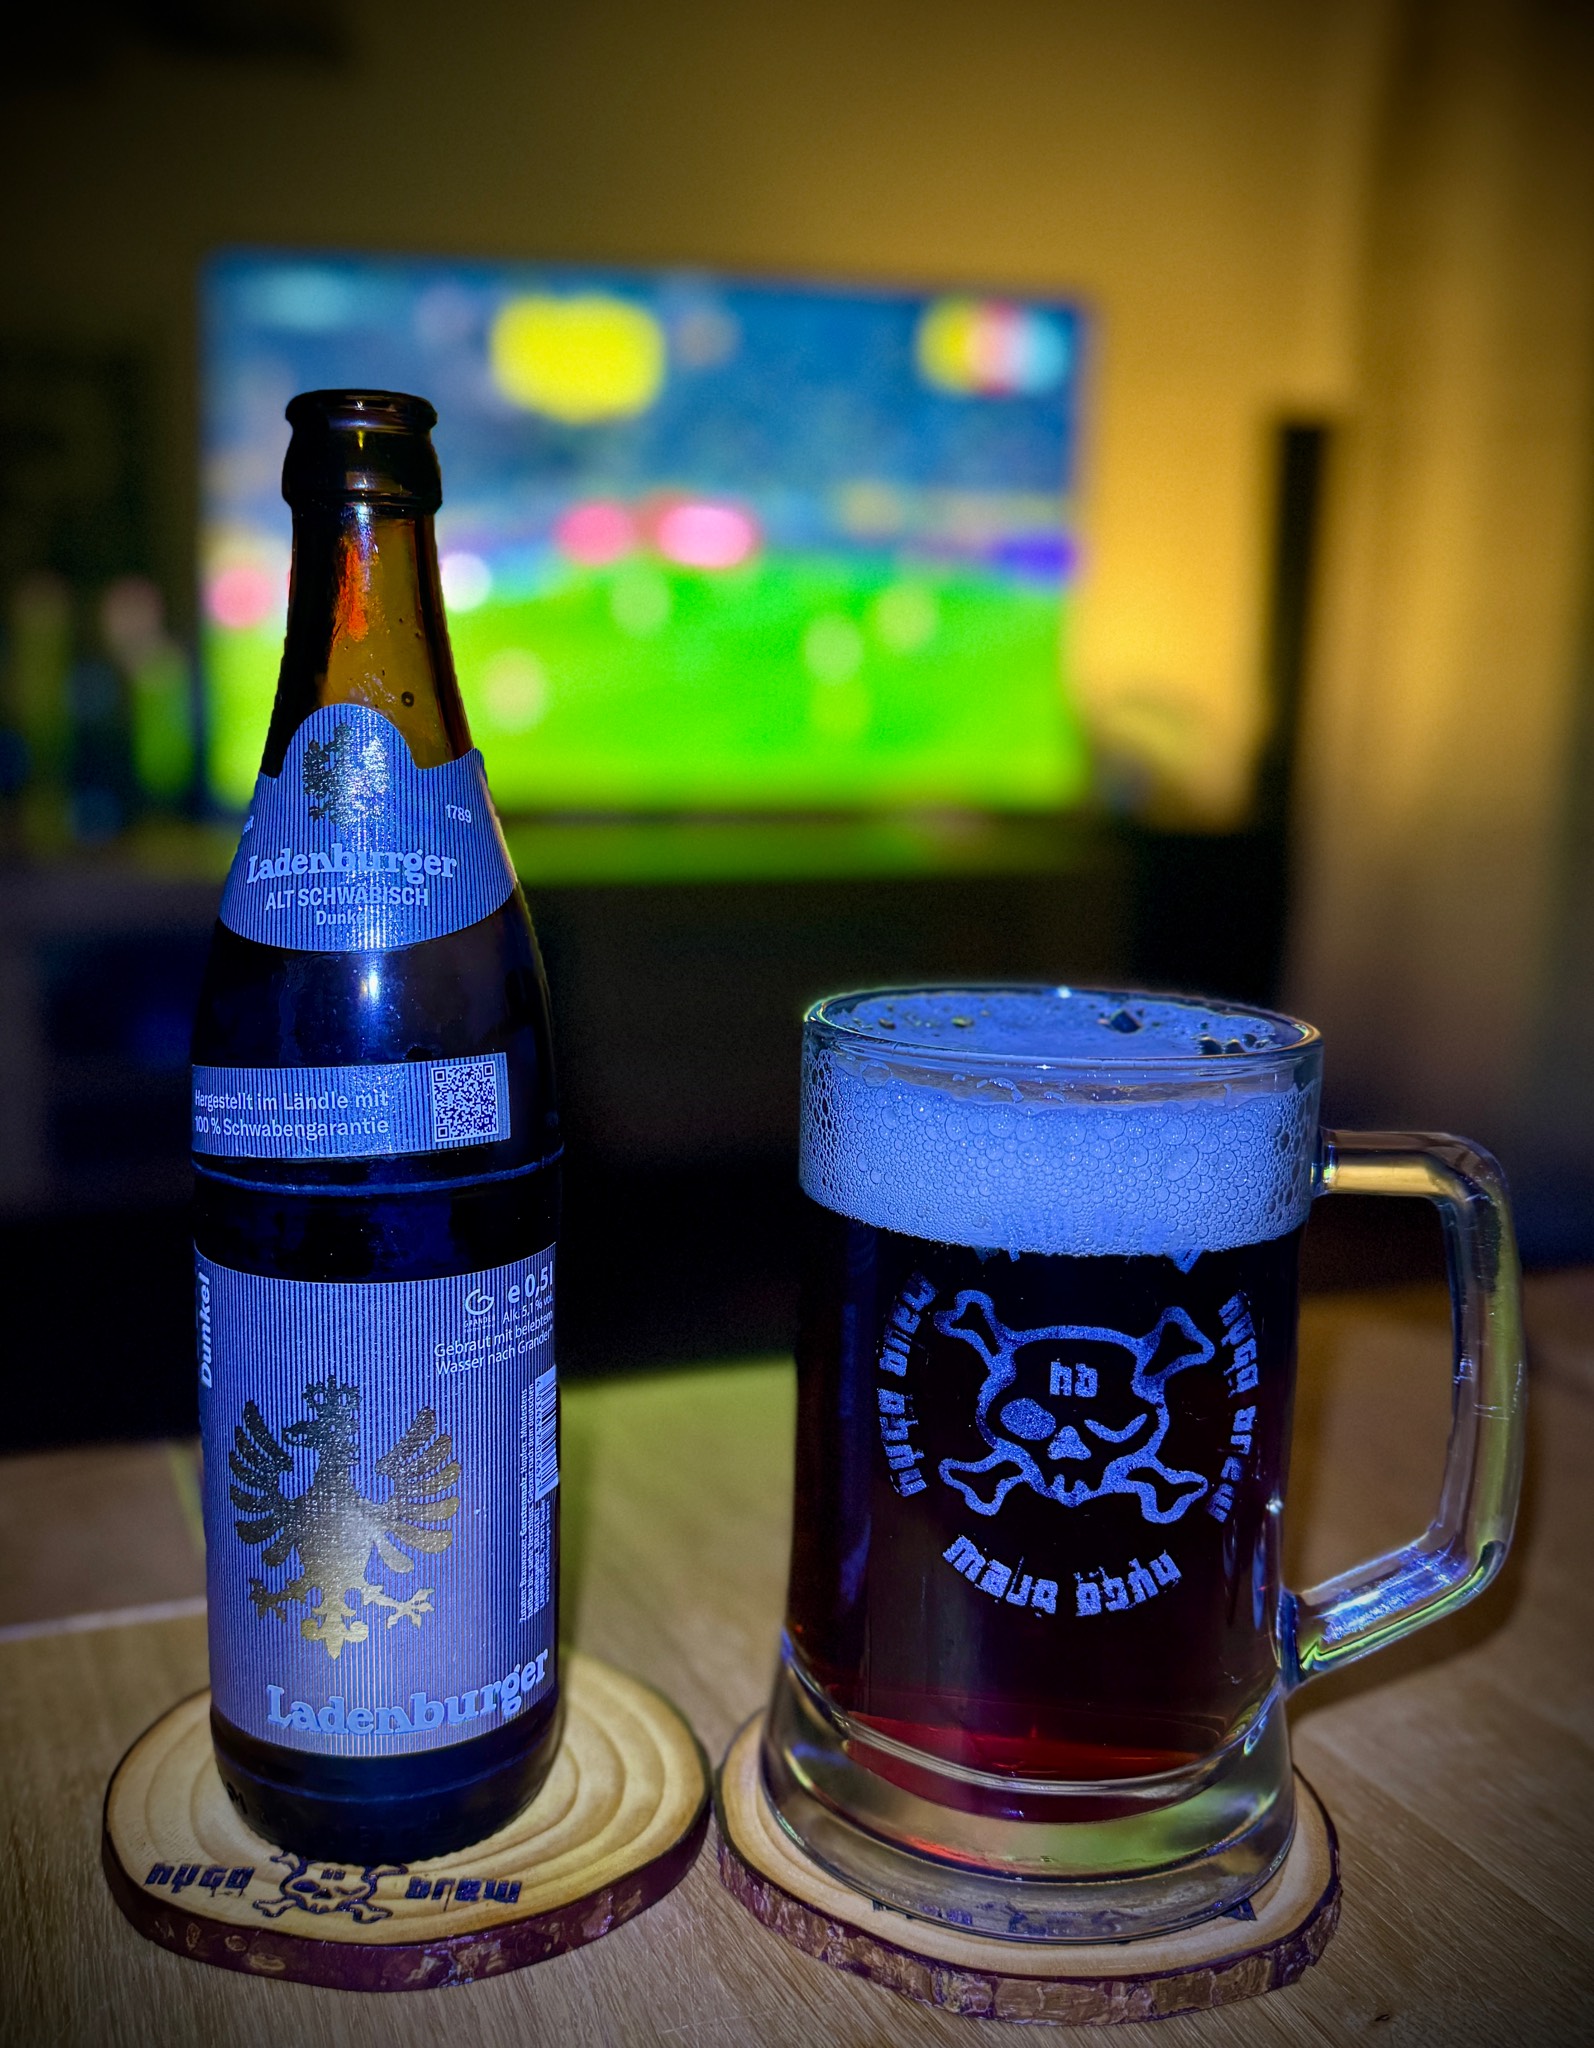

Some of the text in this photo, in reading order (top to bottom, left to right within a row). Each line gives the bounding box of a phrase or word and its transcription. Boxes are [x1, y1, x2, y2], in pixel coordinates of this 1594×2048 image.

[446, 804, 473, 824] 1789
[246, 843, 458, 885] Ladenburger
[264, 889, 295, 911] ALT
[316, 910, 376, 926] Dunke
[195, 1089, 390, 1112] Hergestellt im Ländle mit
[223, 1116, 390, 1141] Schwabengarantie
[199, 1271, 212, 1388] Dunkel
[434, 1335, 492, 1357] Gebraut
[494, 1328, 513, 1345] mit
[515, 1310, 553, 1339] belebtem
[436, 1355, 485, 1375] Wasser
[488, 1344, 516, 1365] nach
[520, 1388, 528, 1439] Mindestens
[266, 1647, 549, 1735] Ladenburger
